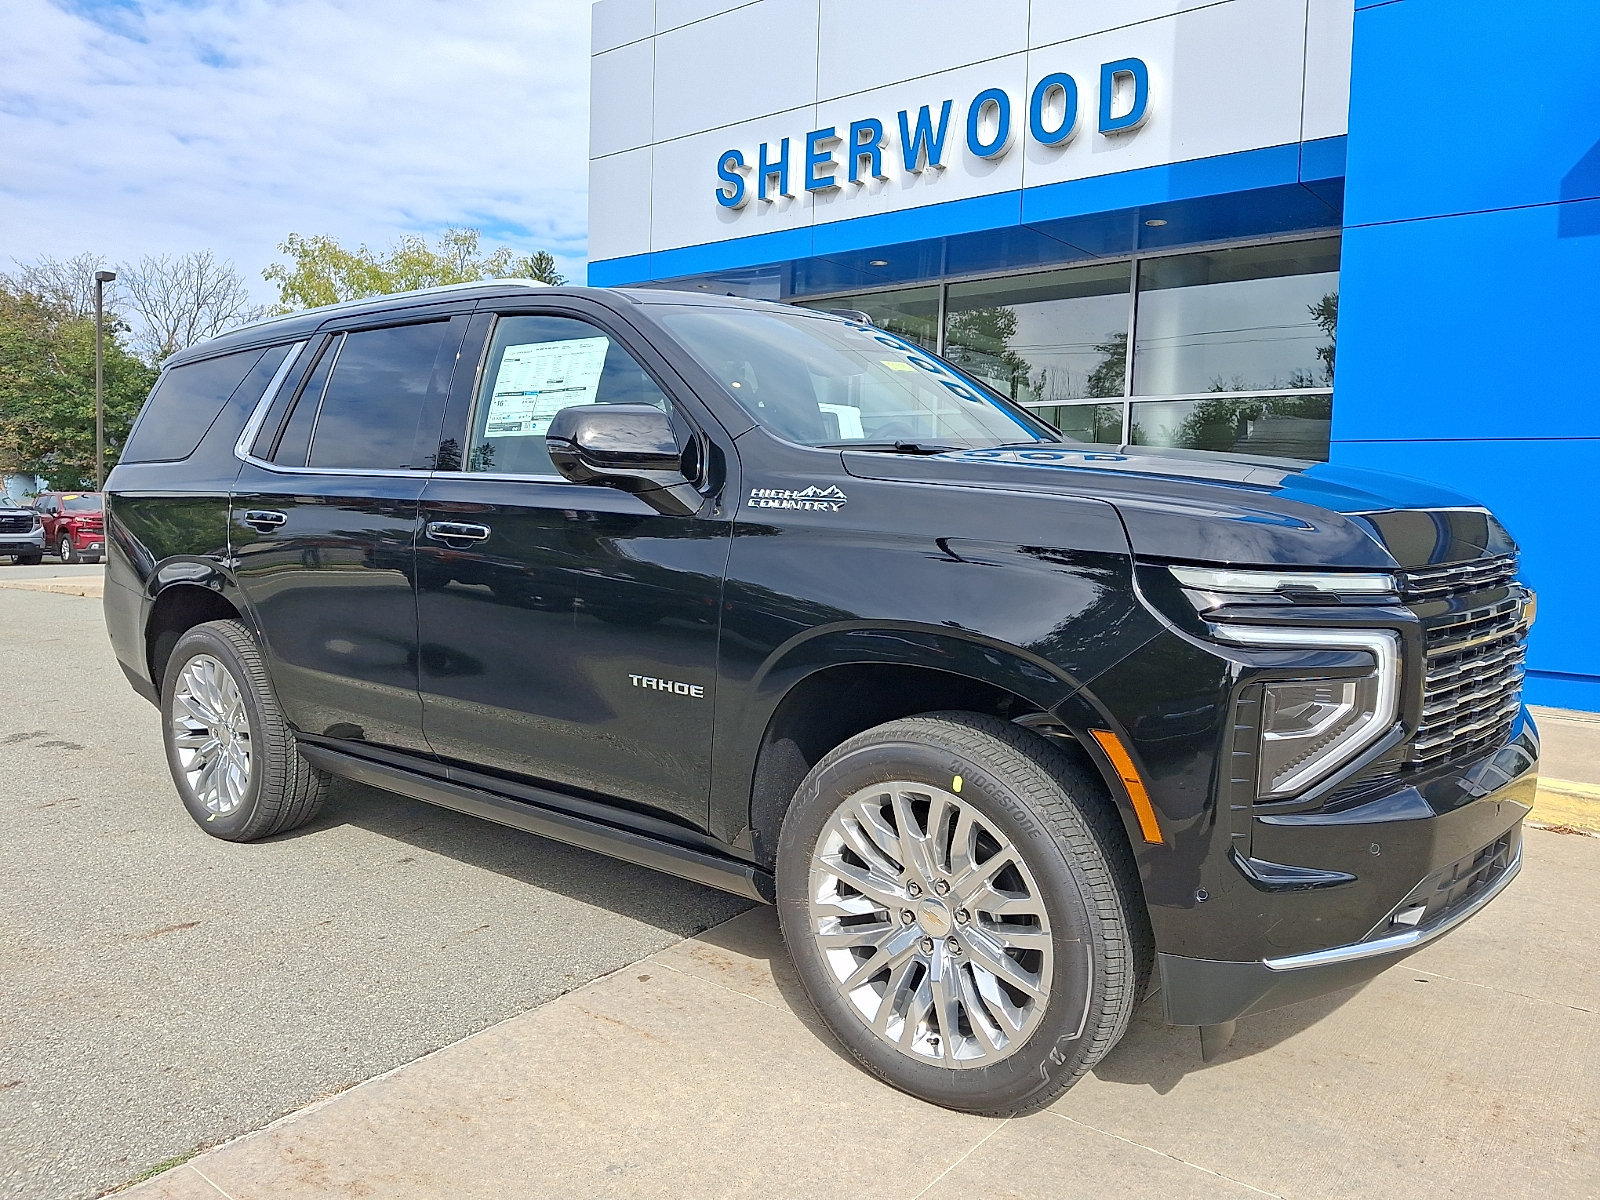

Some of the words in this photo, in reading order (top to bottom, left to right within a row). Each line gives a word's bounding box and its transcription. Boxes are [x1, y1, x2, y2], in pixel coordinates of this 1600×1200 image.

[715, 57, 1150, 209] SHERWOOD
[747, 498, 846, 513] COUNTRY
[750, 488, 800, 500] HIGH
[628, 673, 704, 699] TAHOE
[948, 760, 1042, 840] BRIDGESTONE
